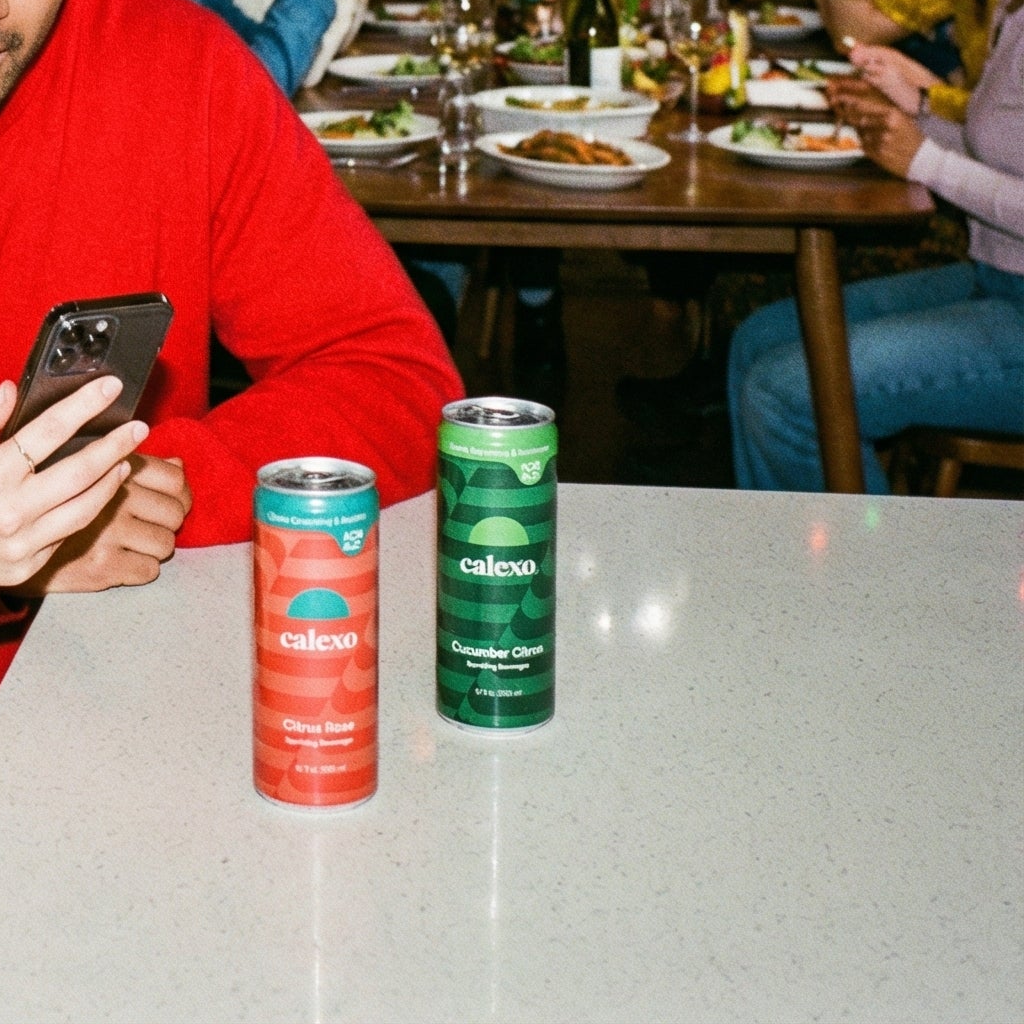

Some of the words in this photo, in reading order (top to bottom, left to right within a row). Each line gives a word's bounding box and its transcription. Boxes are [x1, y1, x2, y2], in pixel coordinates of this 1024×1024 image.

[460, 554, 536, 577] calexo
[280, 628, 358, 651] calexo
[452, 640, 510, 659] Cucumber
